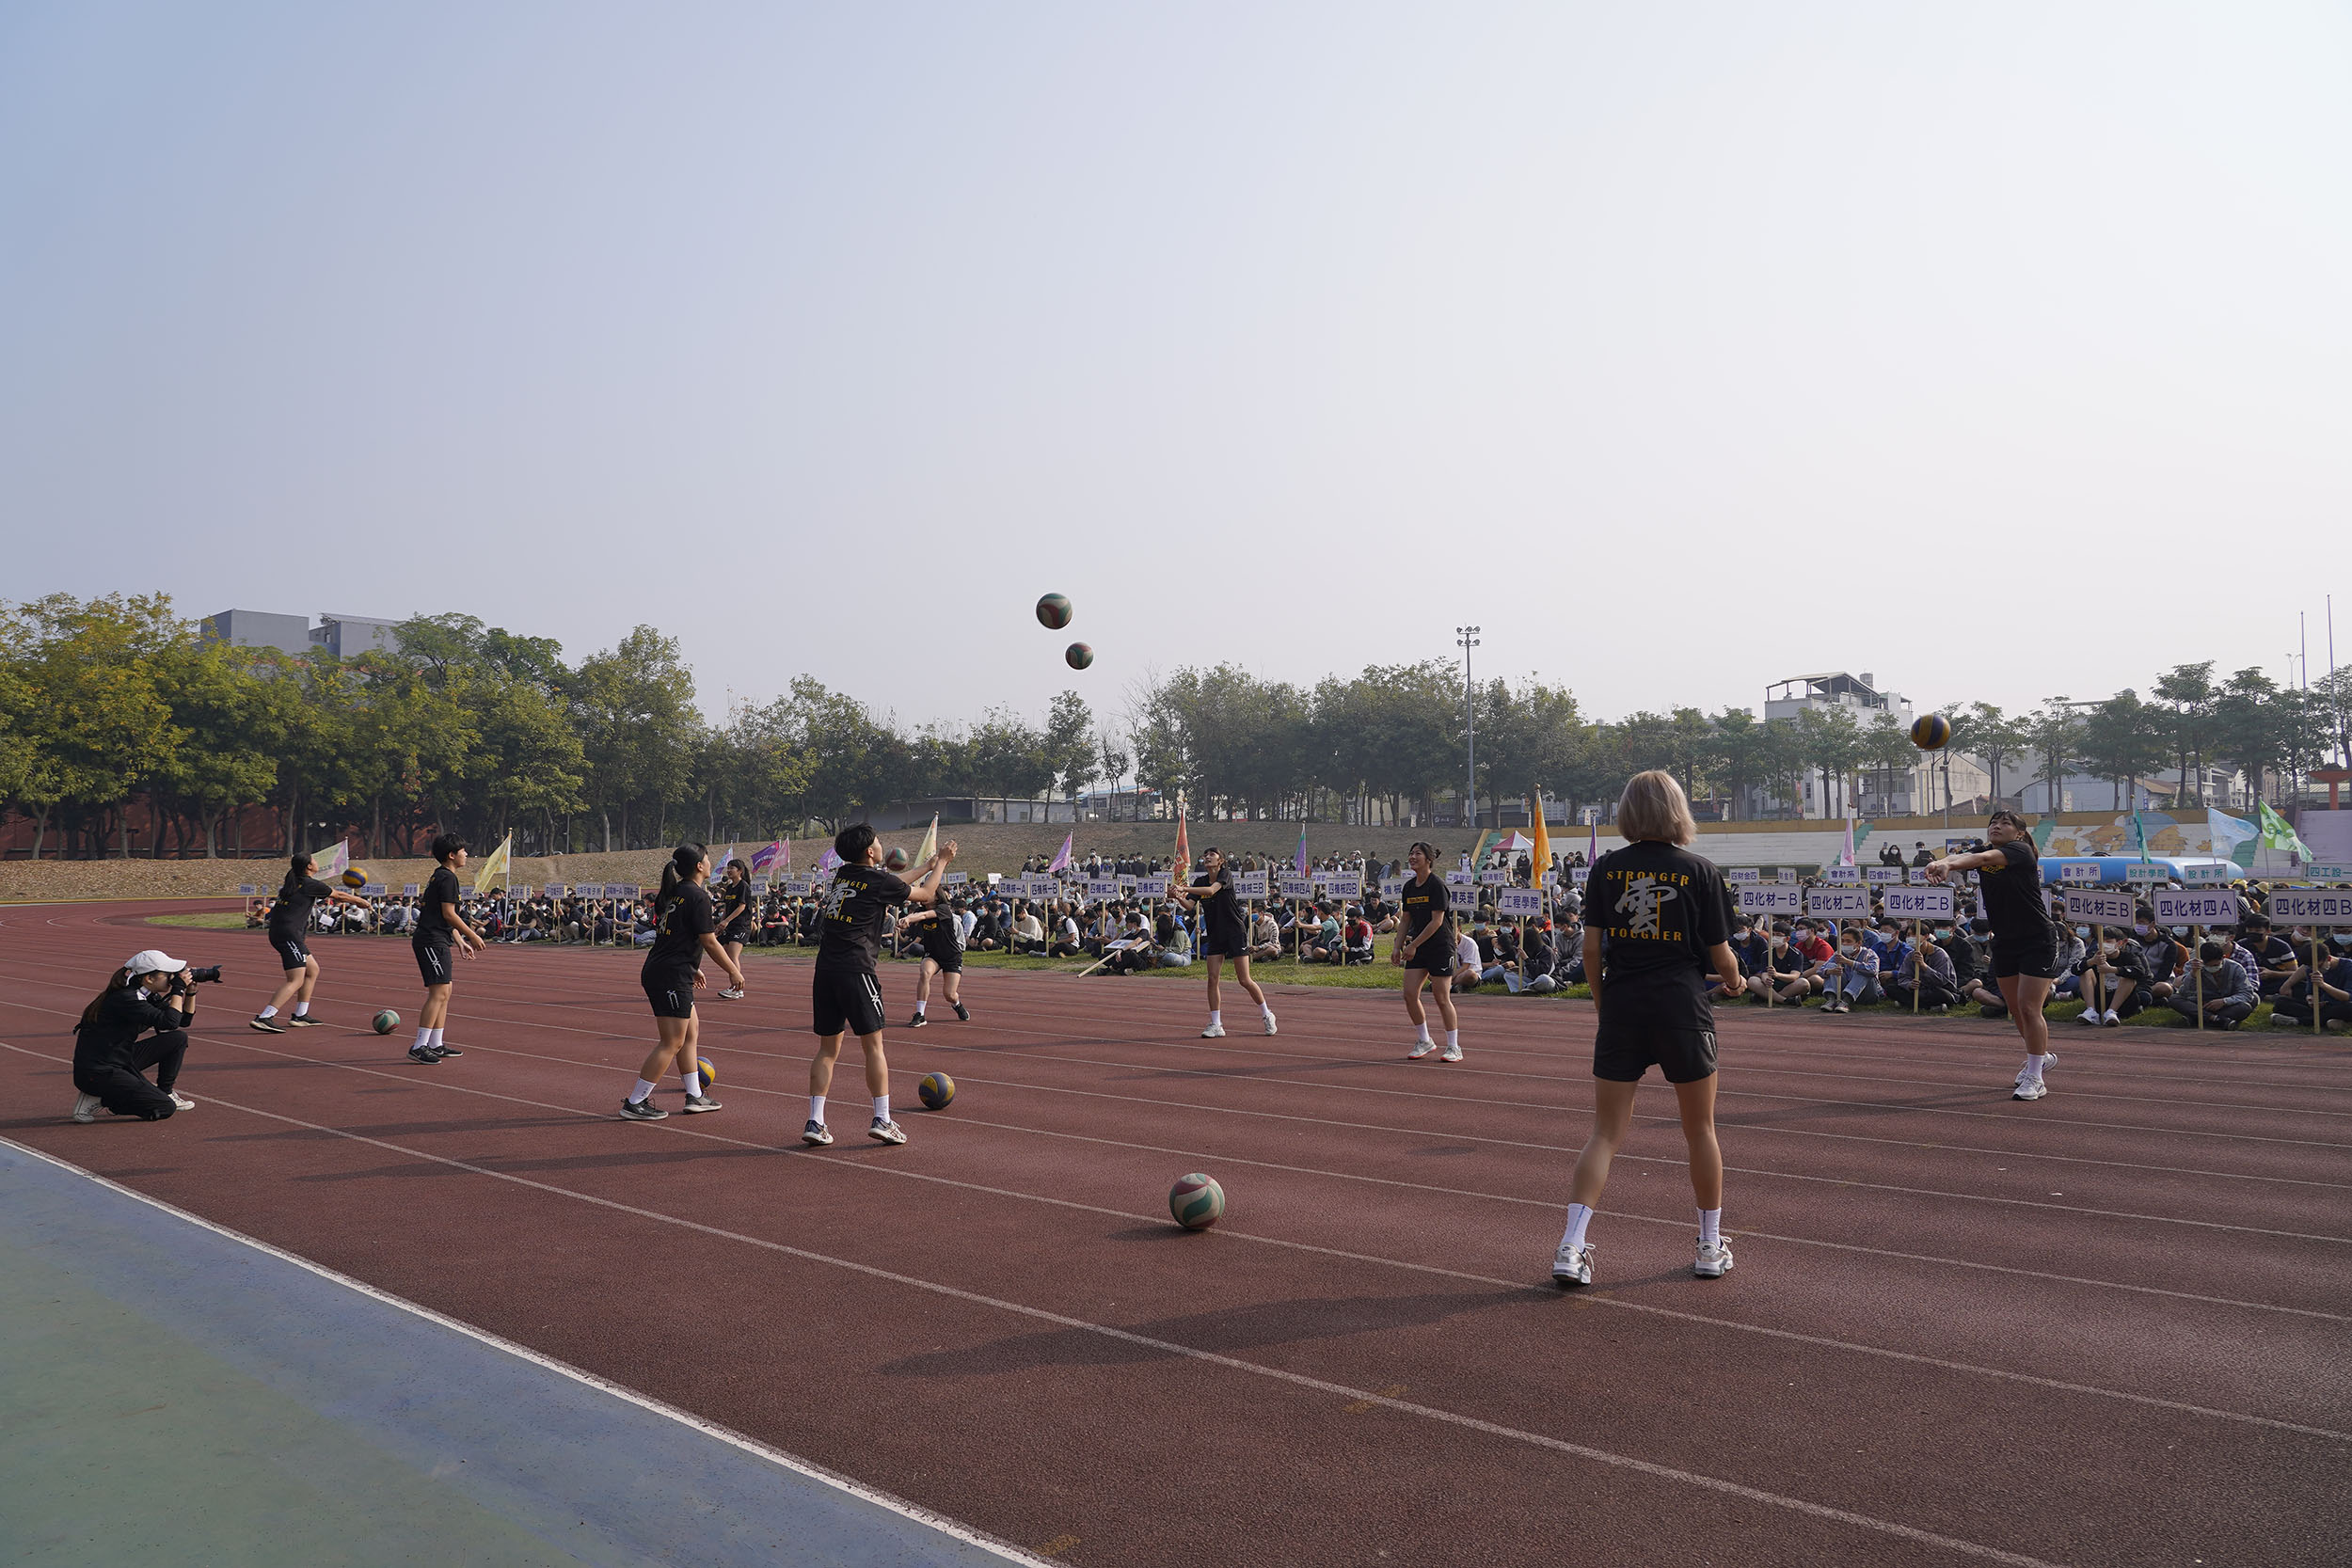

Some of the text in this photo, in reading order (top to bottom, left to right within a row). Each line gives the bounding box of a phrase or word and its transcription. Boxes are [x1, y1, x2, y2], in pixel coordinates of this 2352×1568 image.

[1606, 870, 1690, 886] STRONGER
[1831, 870, 1855, 879] 會計系
[2063, 866, 2097, 878] 會計所
[2129, 868, 2166, 879] 設計學院
[2187, 869, 2223, 879] 設計所
[1452, 891, 1474, 904] 菁英班
[1505, 895, 1539, 910] 工程學院
[1744, 892, 1798, 906] 四化材一B
[1811, 895, 1865, 911] 四化材二A
[1890, 895, 1948, 911] 四化材二B
[2070, 897, 2129, 917] 四化材三B
[2160, 899, 2233, 917] 四化材四A
[2276, 898, 2352, 916] 四化材四B
